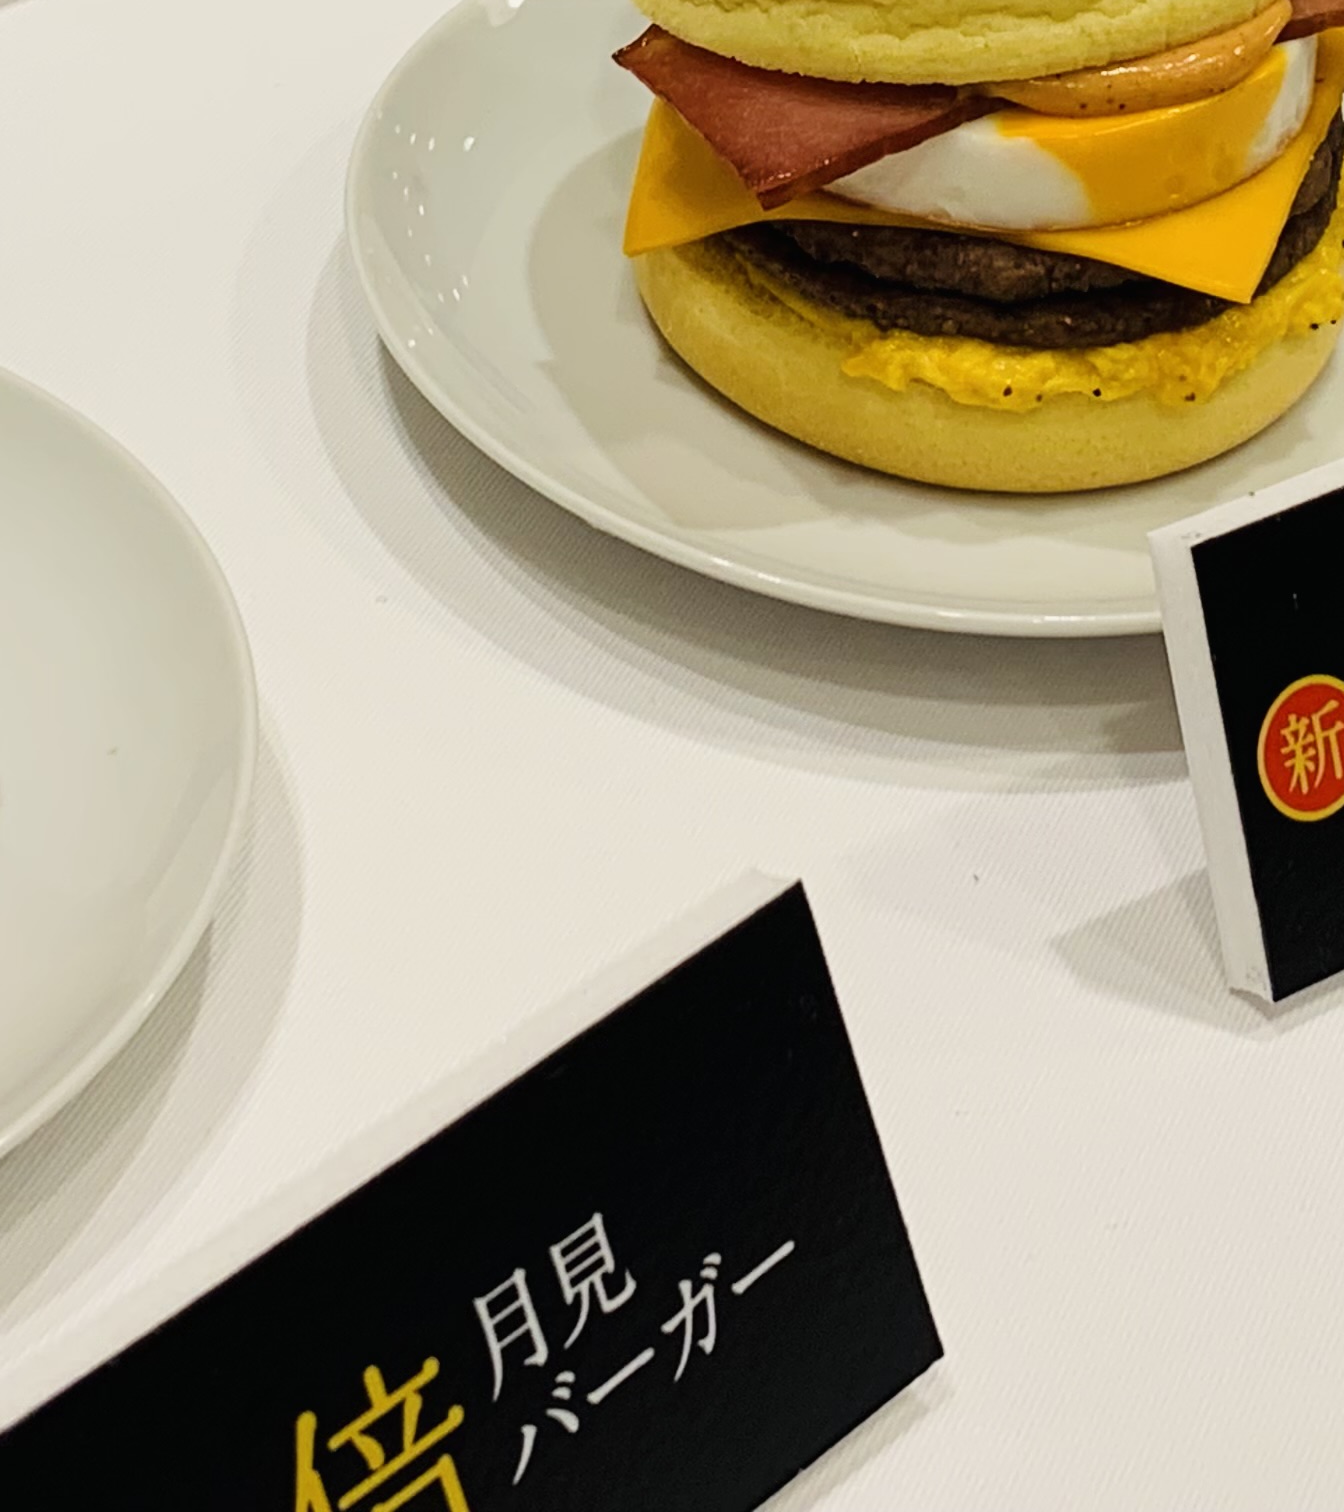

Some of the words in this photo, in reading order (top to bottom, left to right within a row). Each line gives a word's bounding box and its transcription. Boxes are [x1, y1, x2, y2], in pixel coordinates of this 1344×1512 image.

[474, 1212, 637, 1401] 月見
[512, 1240, 795, 1485] バーガー
